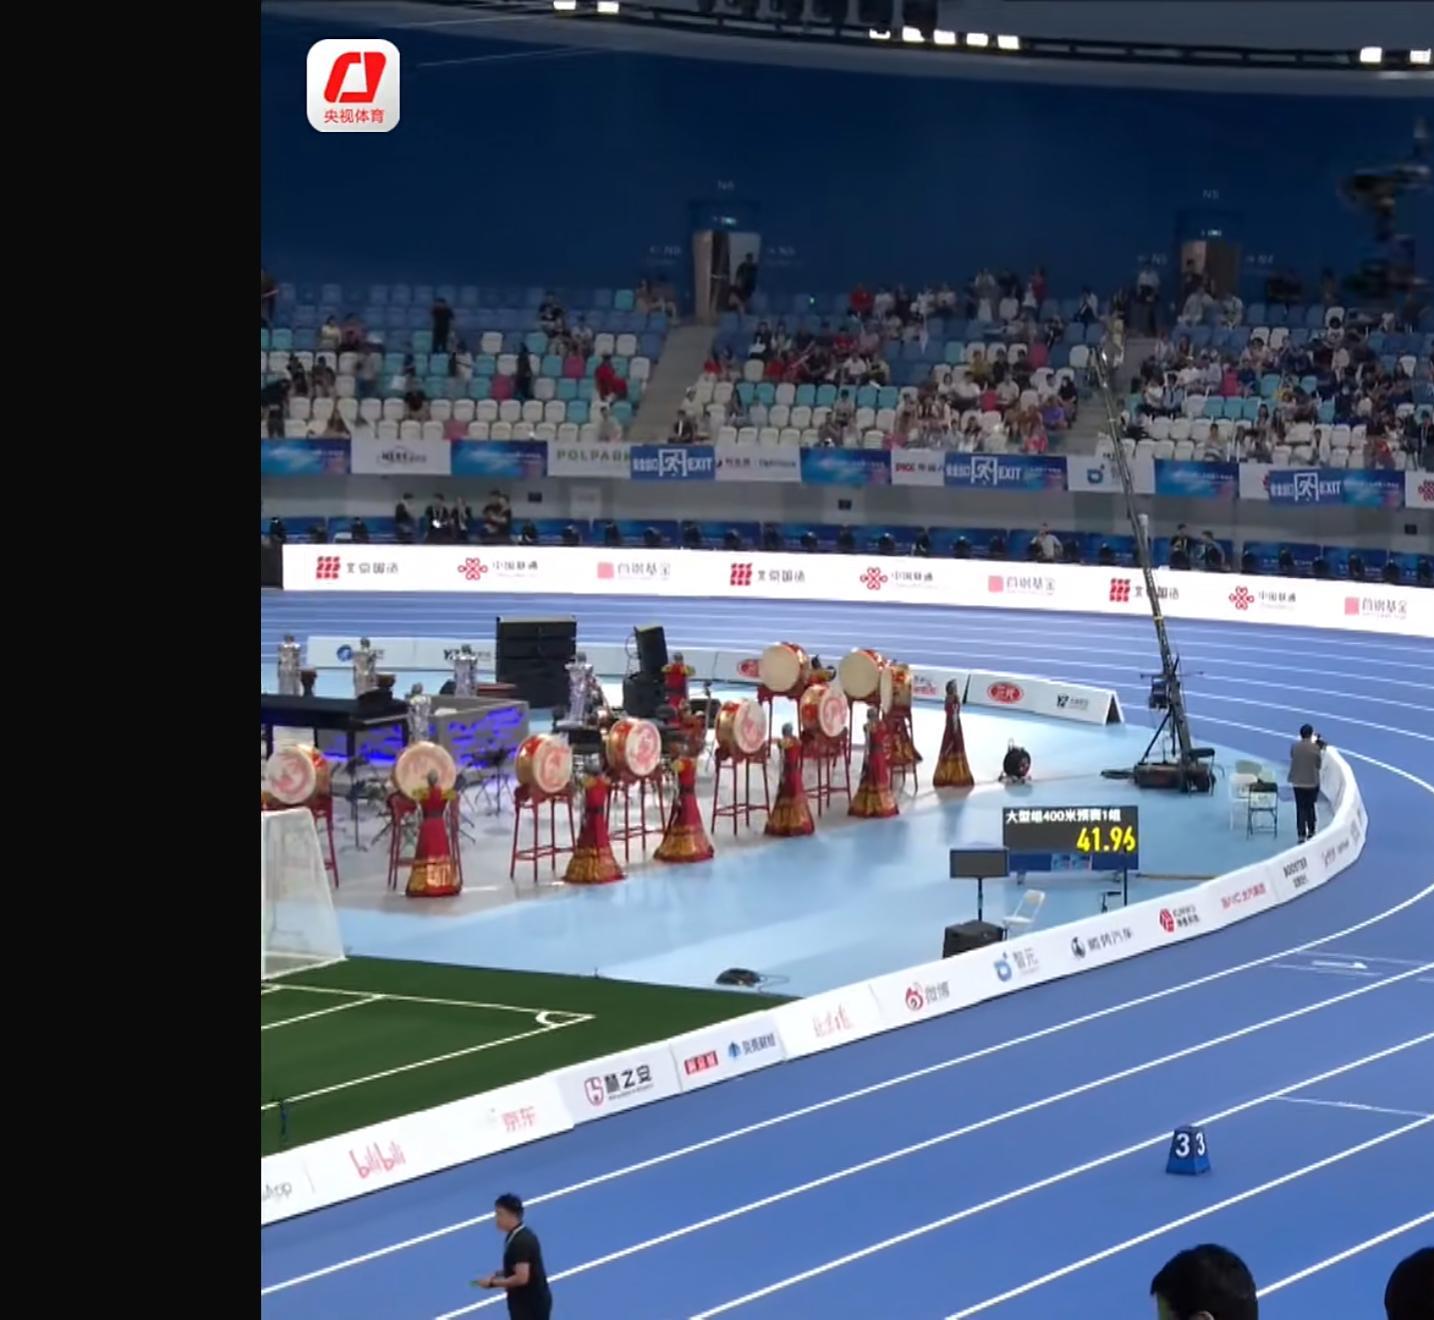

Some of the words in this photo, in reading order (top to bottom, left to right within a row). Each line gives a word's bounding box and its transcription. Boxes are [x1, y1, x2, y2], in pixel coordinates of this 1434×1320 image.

[687, 457, 713, 472] EXIT
[1320, 480, 1340, 495] EXIT
[1077, 825, 1136, 852] 41.96
[1175, 1132, 1191, 1157] 3
[1195, 1131, 1206, 1157] 3
[349, 1141, 406, 1178] bilibili
